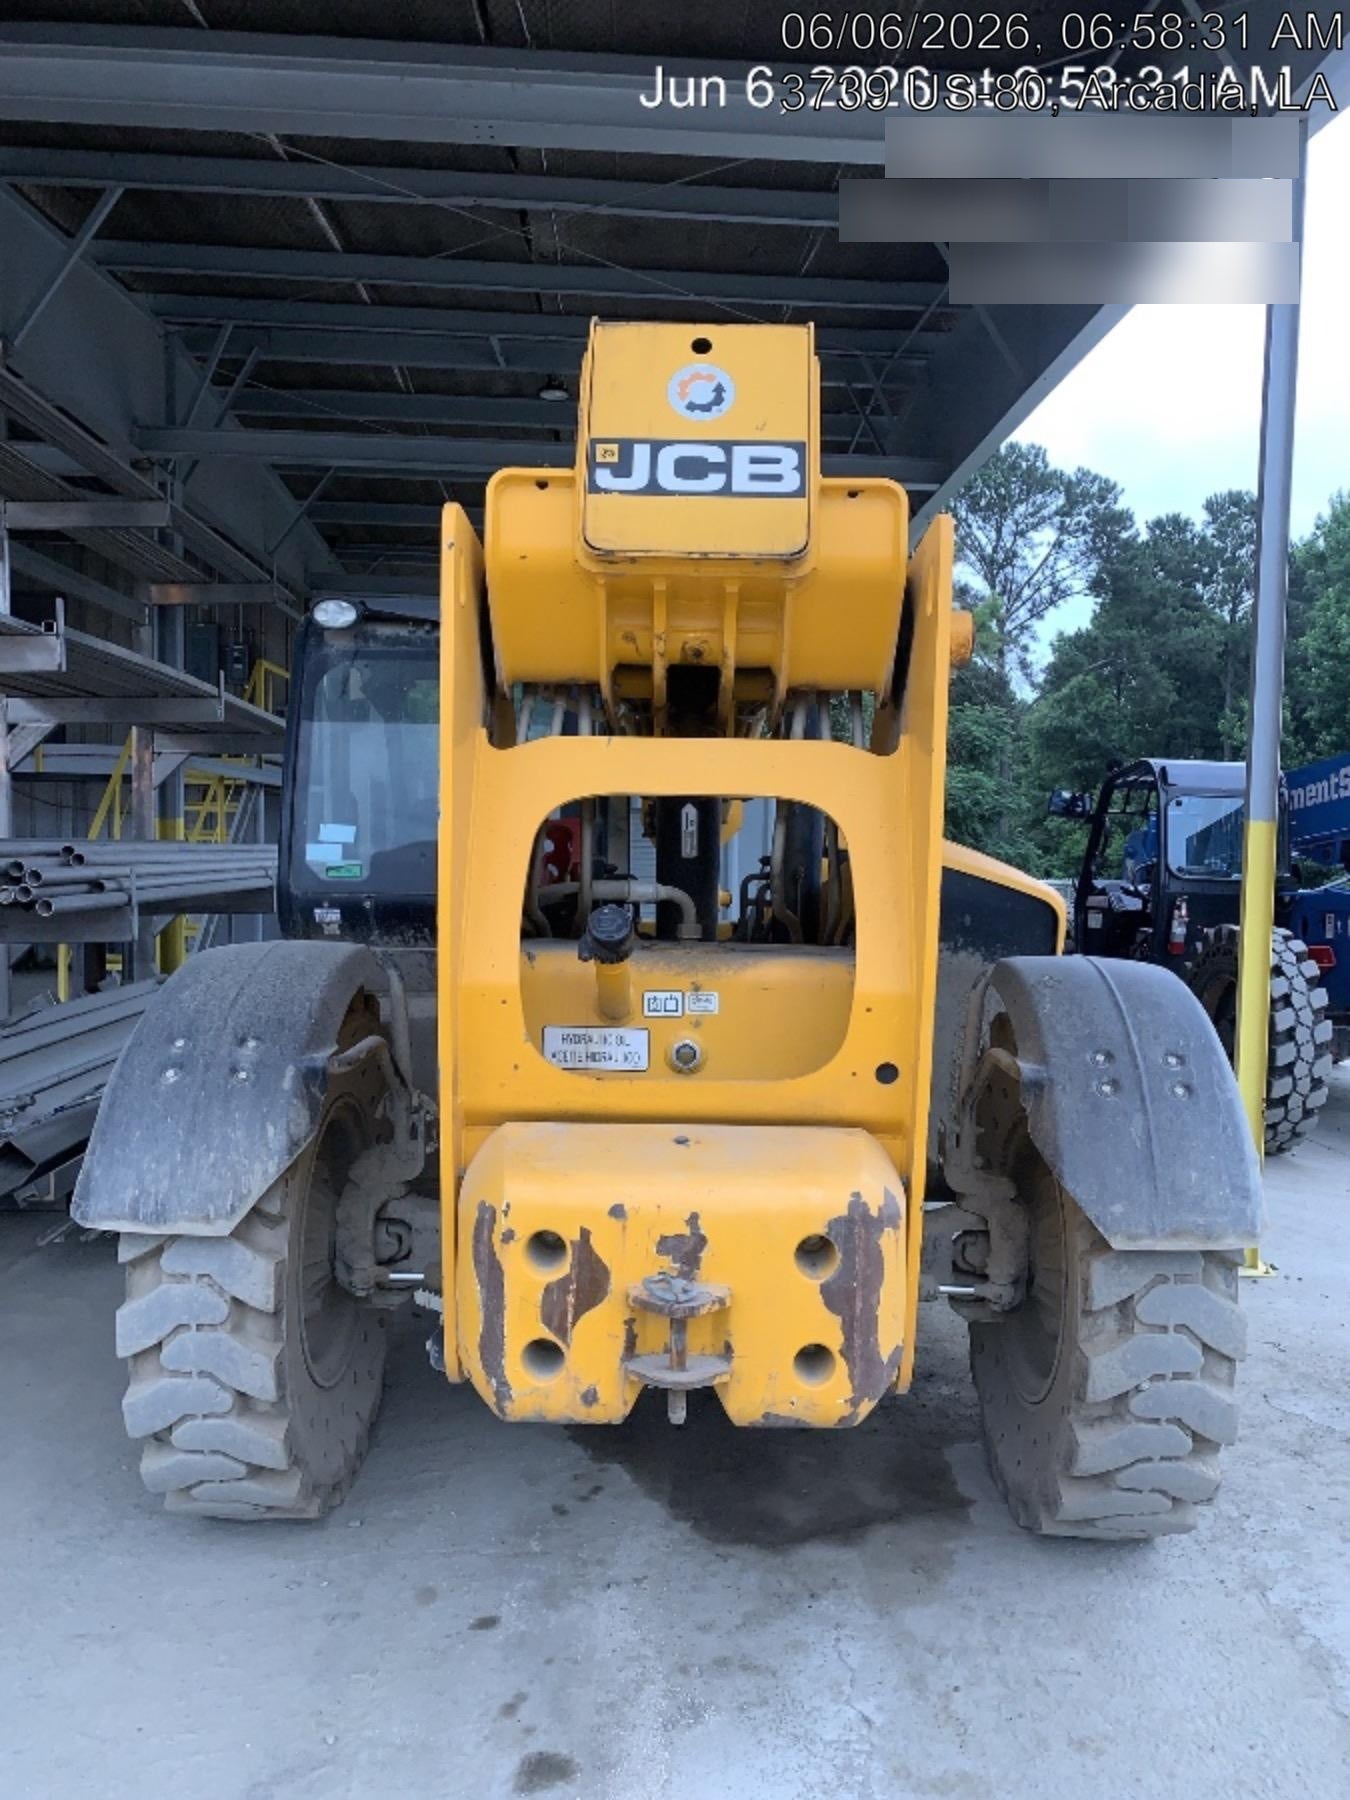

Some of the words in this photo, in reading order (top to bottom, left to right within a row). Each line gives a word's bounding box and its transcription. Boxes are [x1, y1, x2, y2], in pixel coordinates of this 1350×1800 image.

[594, 442, 801, 494] JCB
[561, 1033, 614, 1046] HYDRAIC
[585, 1051, 641, 1065] HIDRAICO
